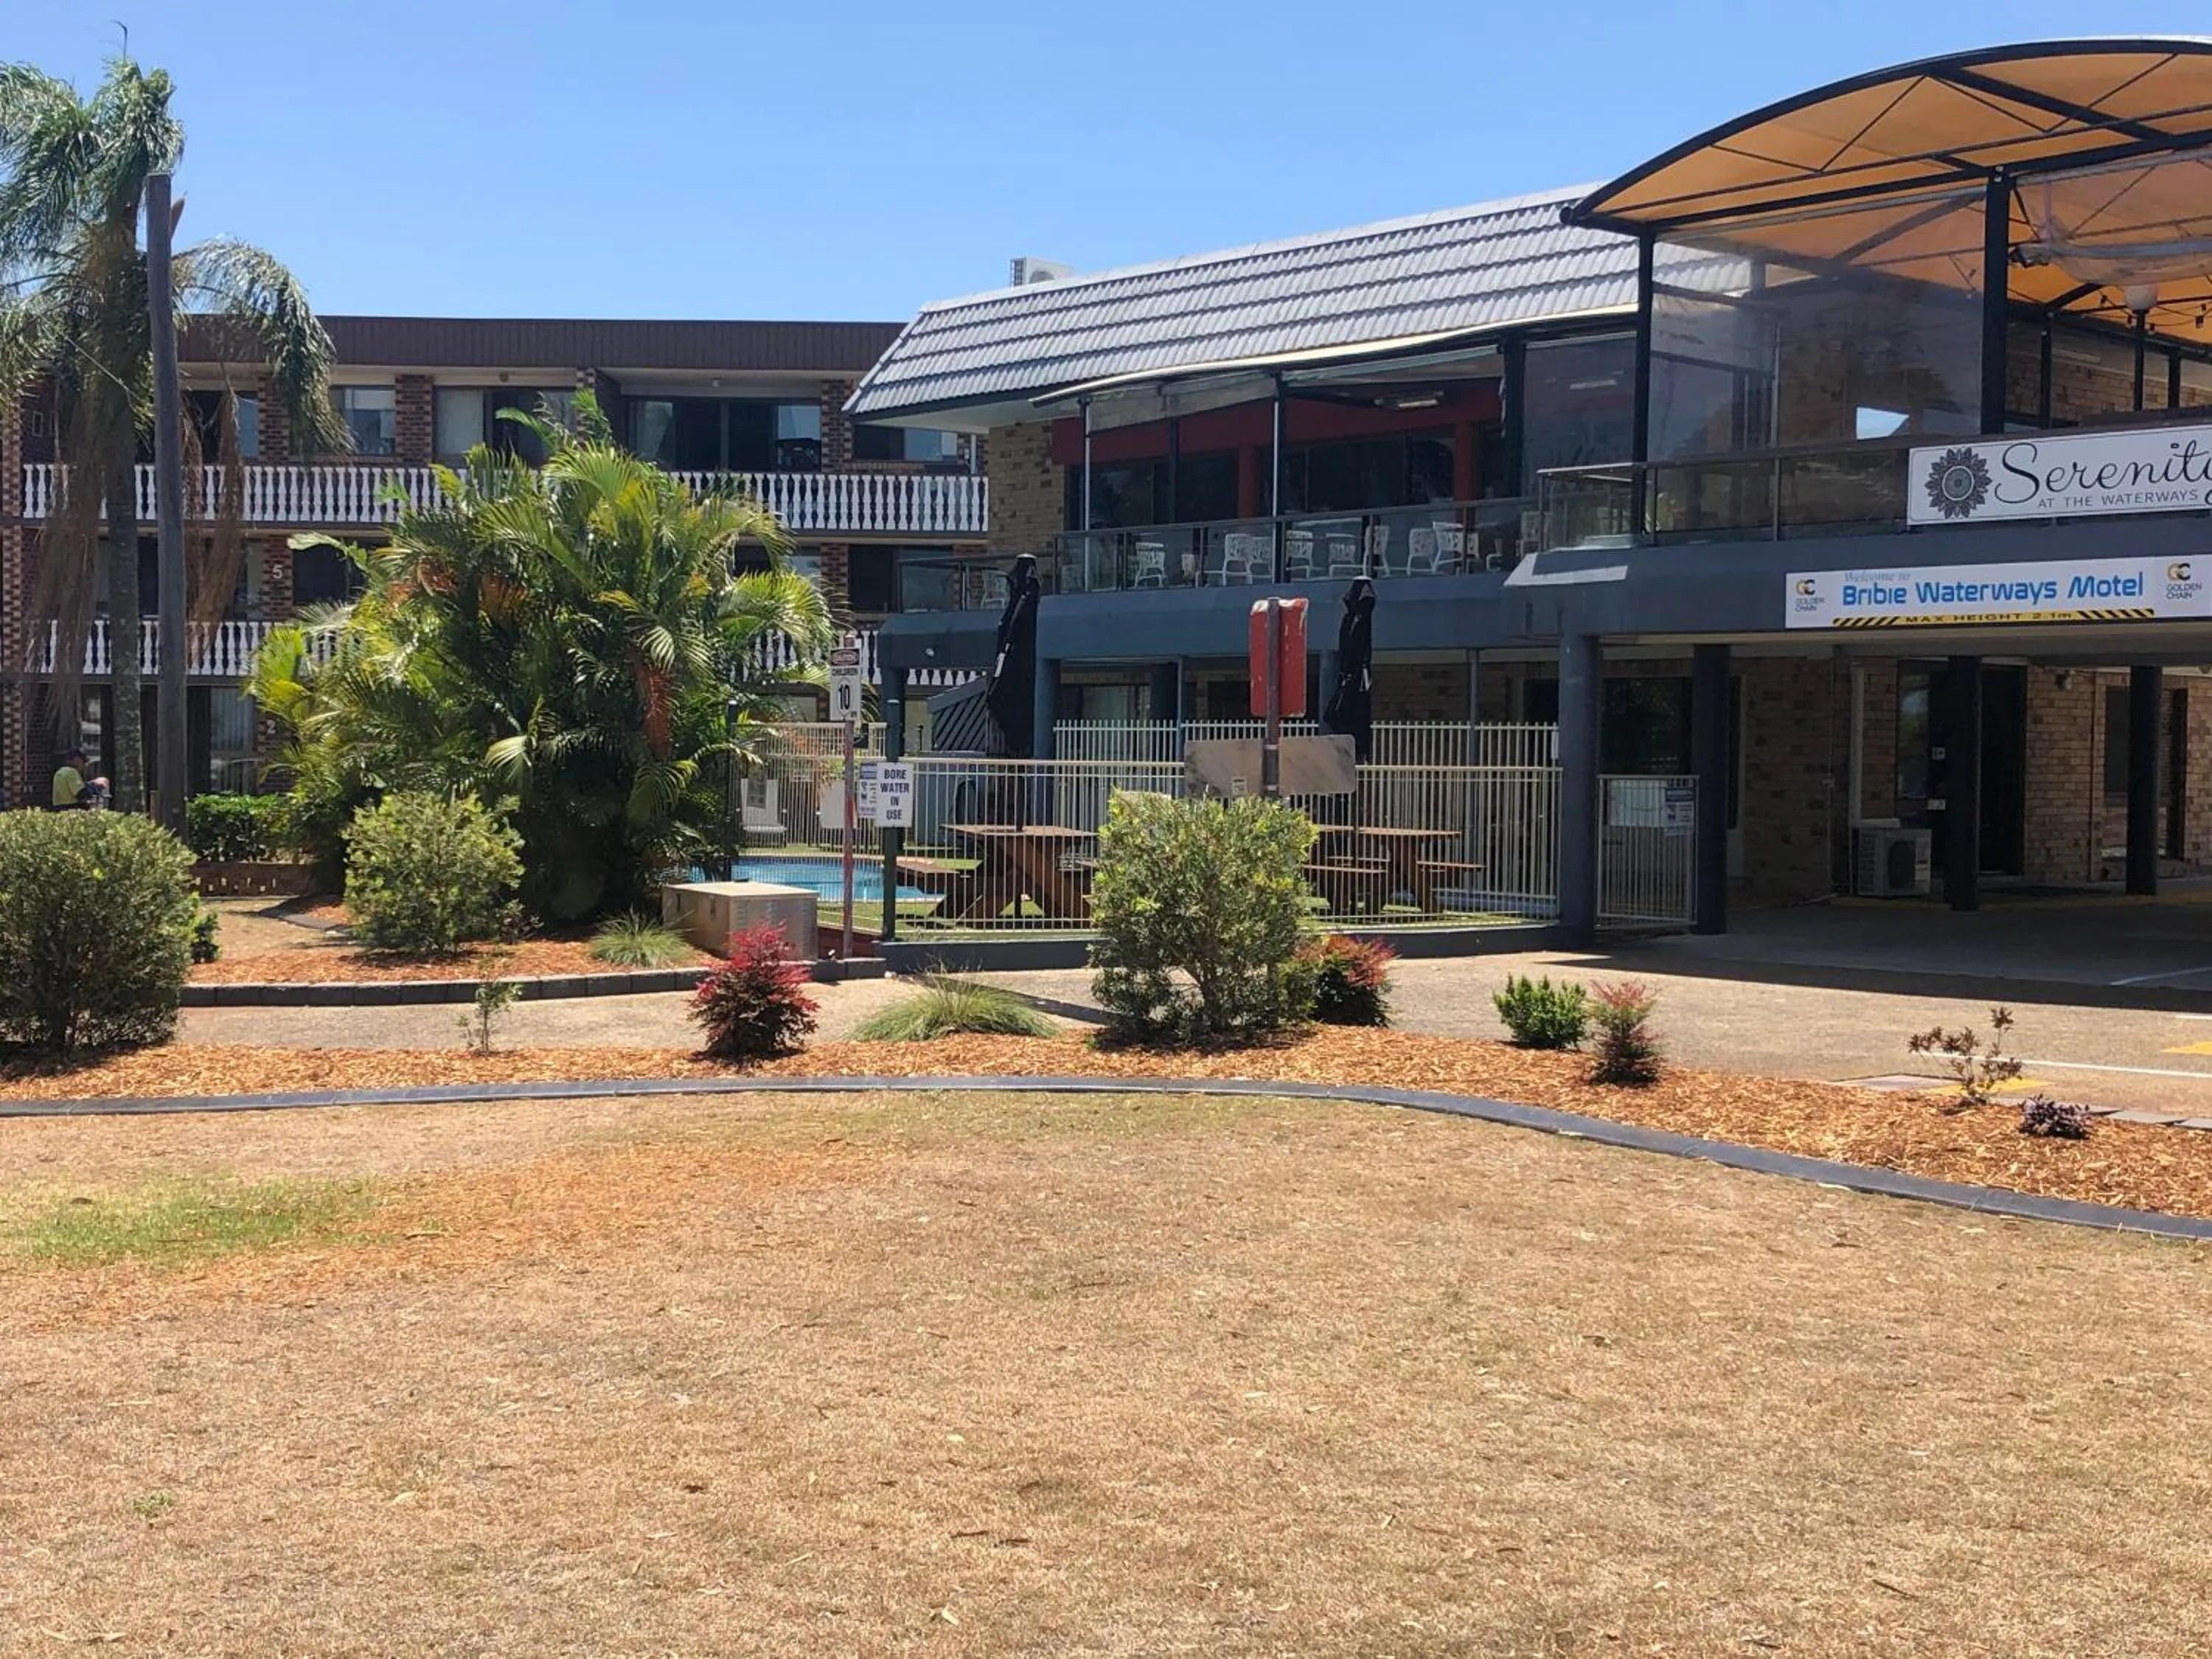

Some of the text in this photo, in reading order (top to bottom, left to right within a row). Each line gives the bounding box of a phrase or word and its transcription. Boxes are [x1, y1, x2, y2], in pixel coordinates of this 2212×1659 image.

[2039, 489, 2198, 509] AT THE WATERWAYS
[272, 564, 283, 579] 5
[1843, 571, 2143, 605] Bribie Waterways Motel
[2166, 582, 2202, 591] GOLDEN
[1905, 615, 1944, 623] MAX
[1954, 613, 2023, 622] HEIGHT
[838, 684, 850, 709] 10
[884, 769, 907, 779] BORE
[880, 782, 909, 793] WATER
[890, 796, 899, 806] IN
[886, 810, 902, 821] USE
